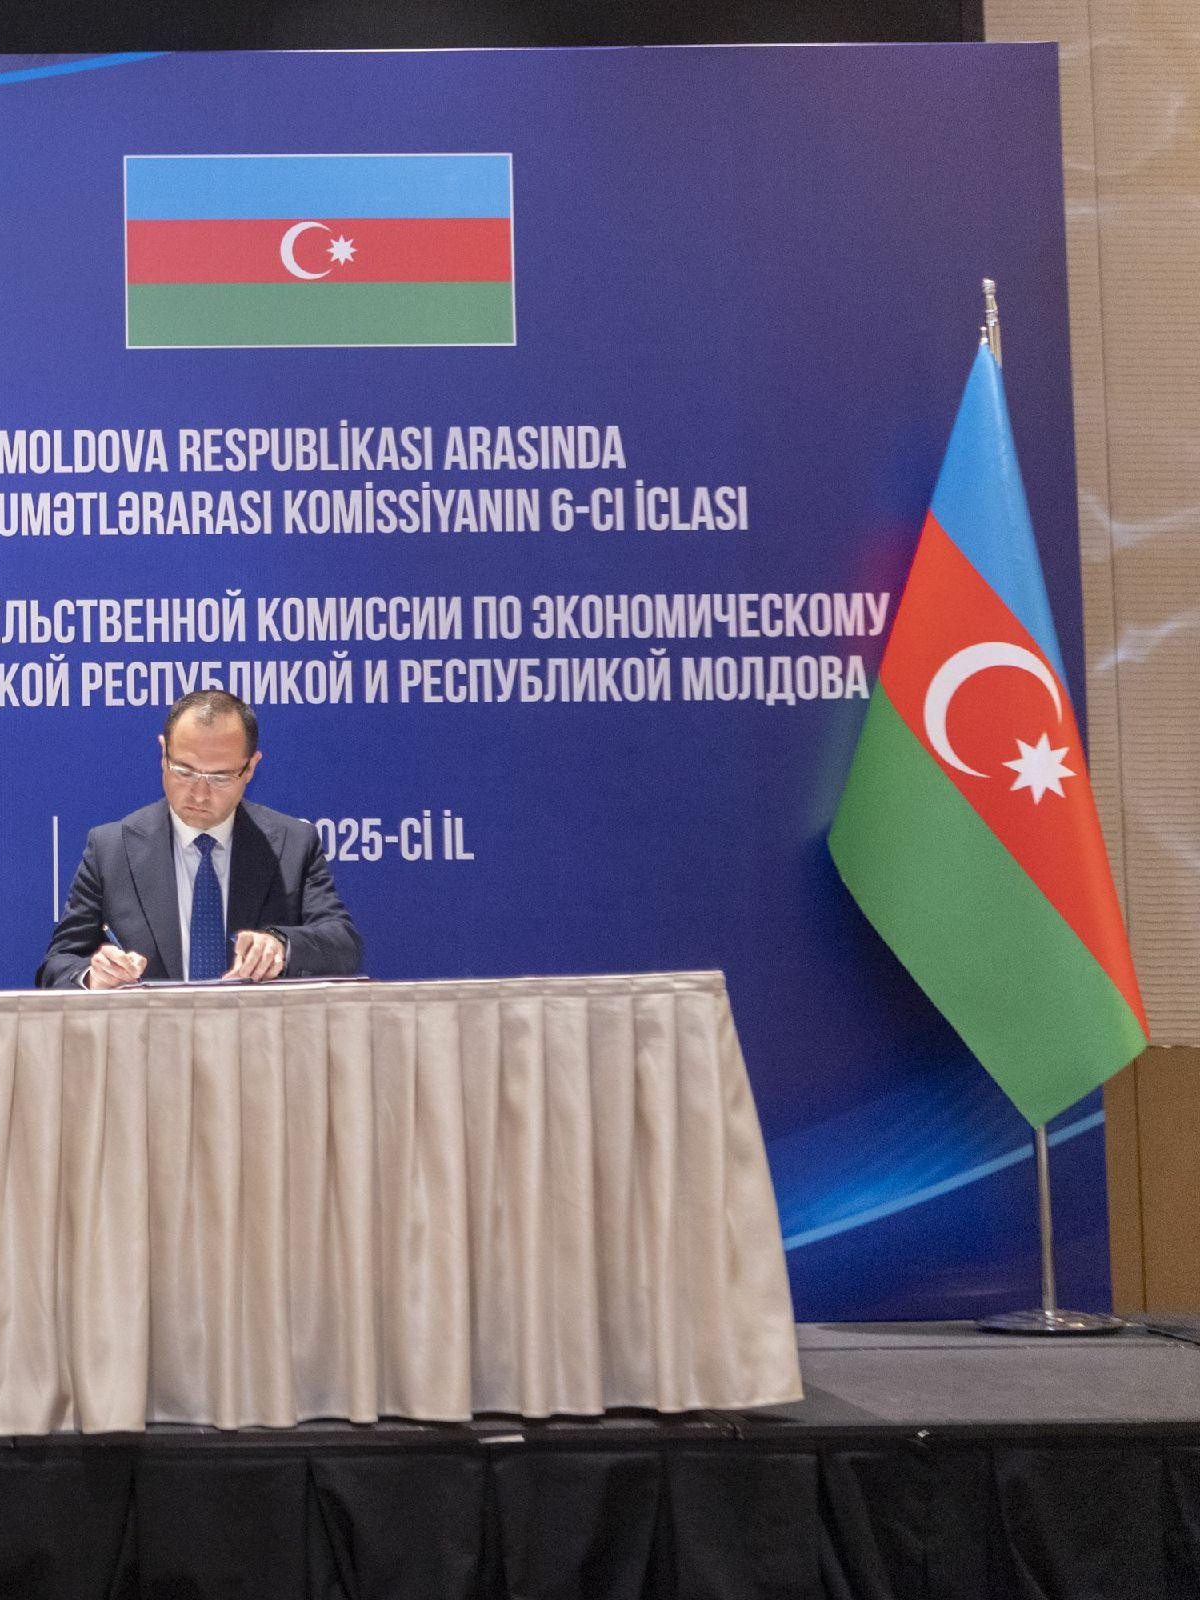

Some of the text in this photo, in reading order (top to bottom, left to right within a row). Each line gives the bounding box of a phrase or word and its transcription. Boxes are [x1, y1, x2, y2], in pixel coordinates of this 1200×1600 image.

[178, 419, 433, 473] RESPUBLİKASI
[443, 425, 627, 471] ARASINDA
[283, 481, 540, 535] KOMİSSİYANIN
[550, 487, 625, 532] 6-CI
[635, 479, 748, 531] İCLASI
[257, 596, 463, 642] КОМИССИИ
[473, 594, 523, 640] ПО
[532, 592, 891, 640] ЭКОНОМИЧЕСКОМУ
[81, 650, 353, 707] РЕСПУБЛИКОЙ
[364, 659, 389, 704] И
[399, 647, 671, 704] РЕСПУБЛИКОЙ
[681, 654, 870, 706] МОЛДОВА
[299, 809, 475, 862] 025-Cİ İL
